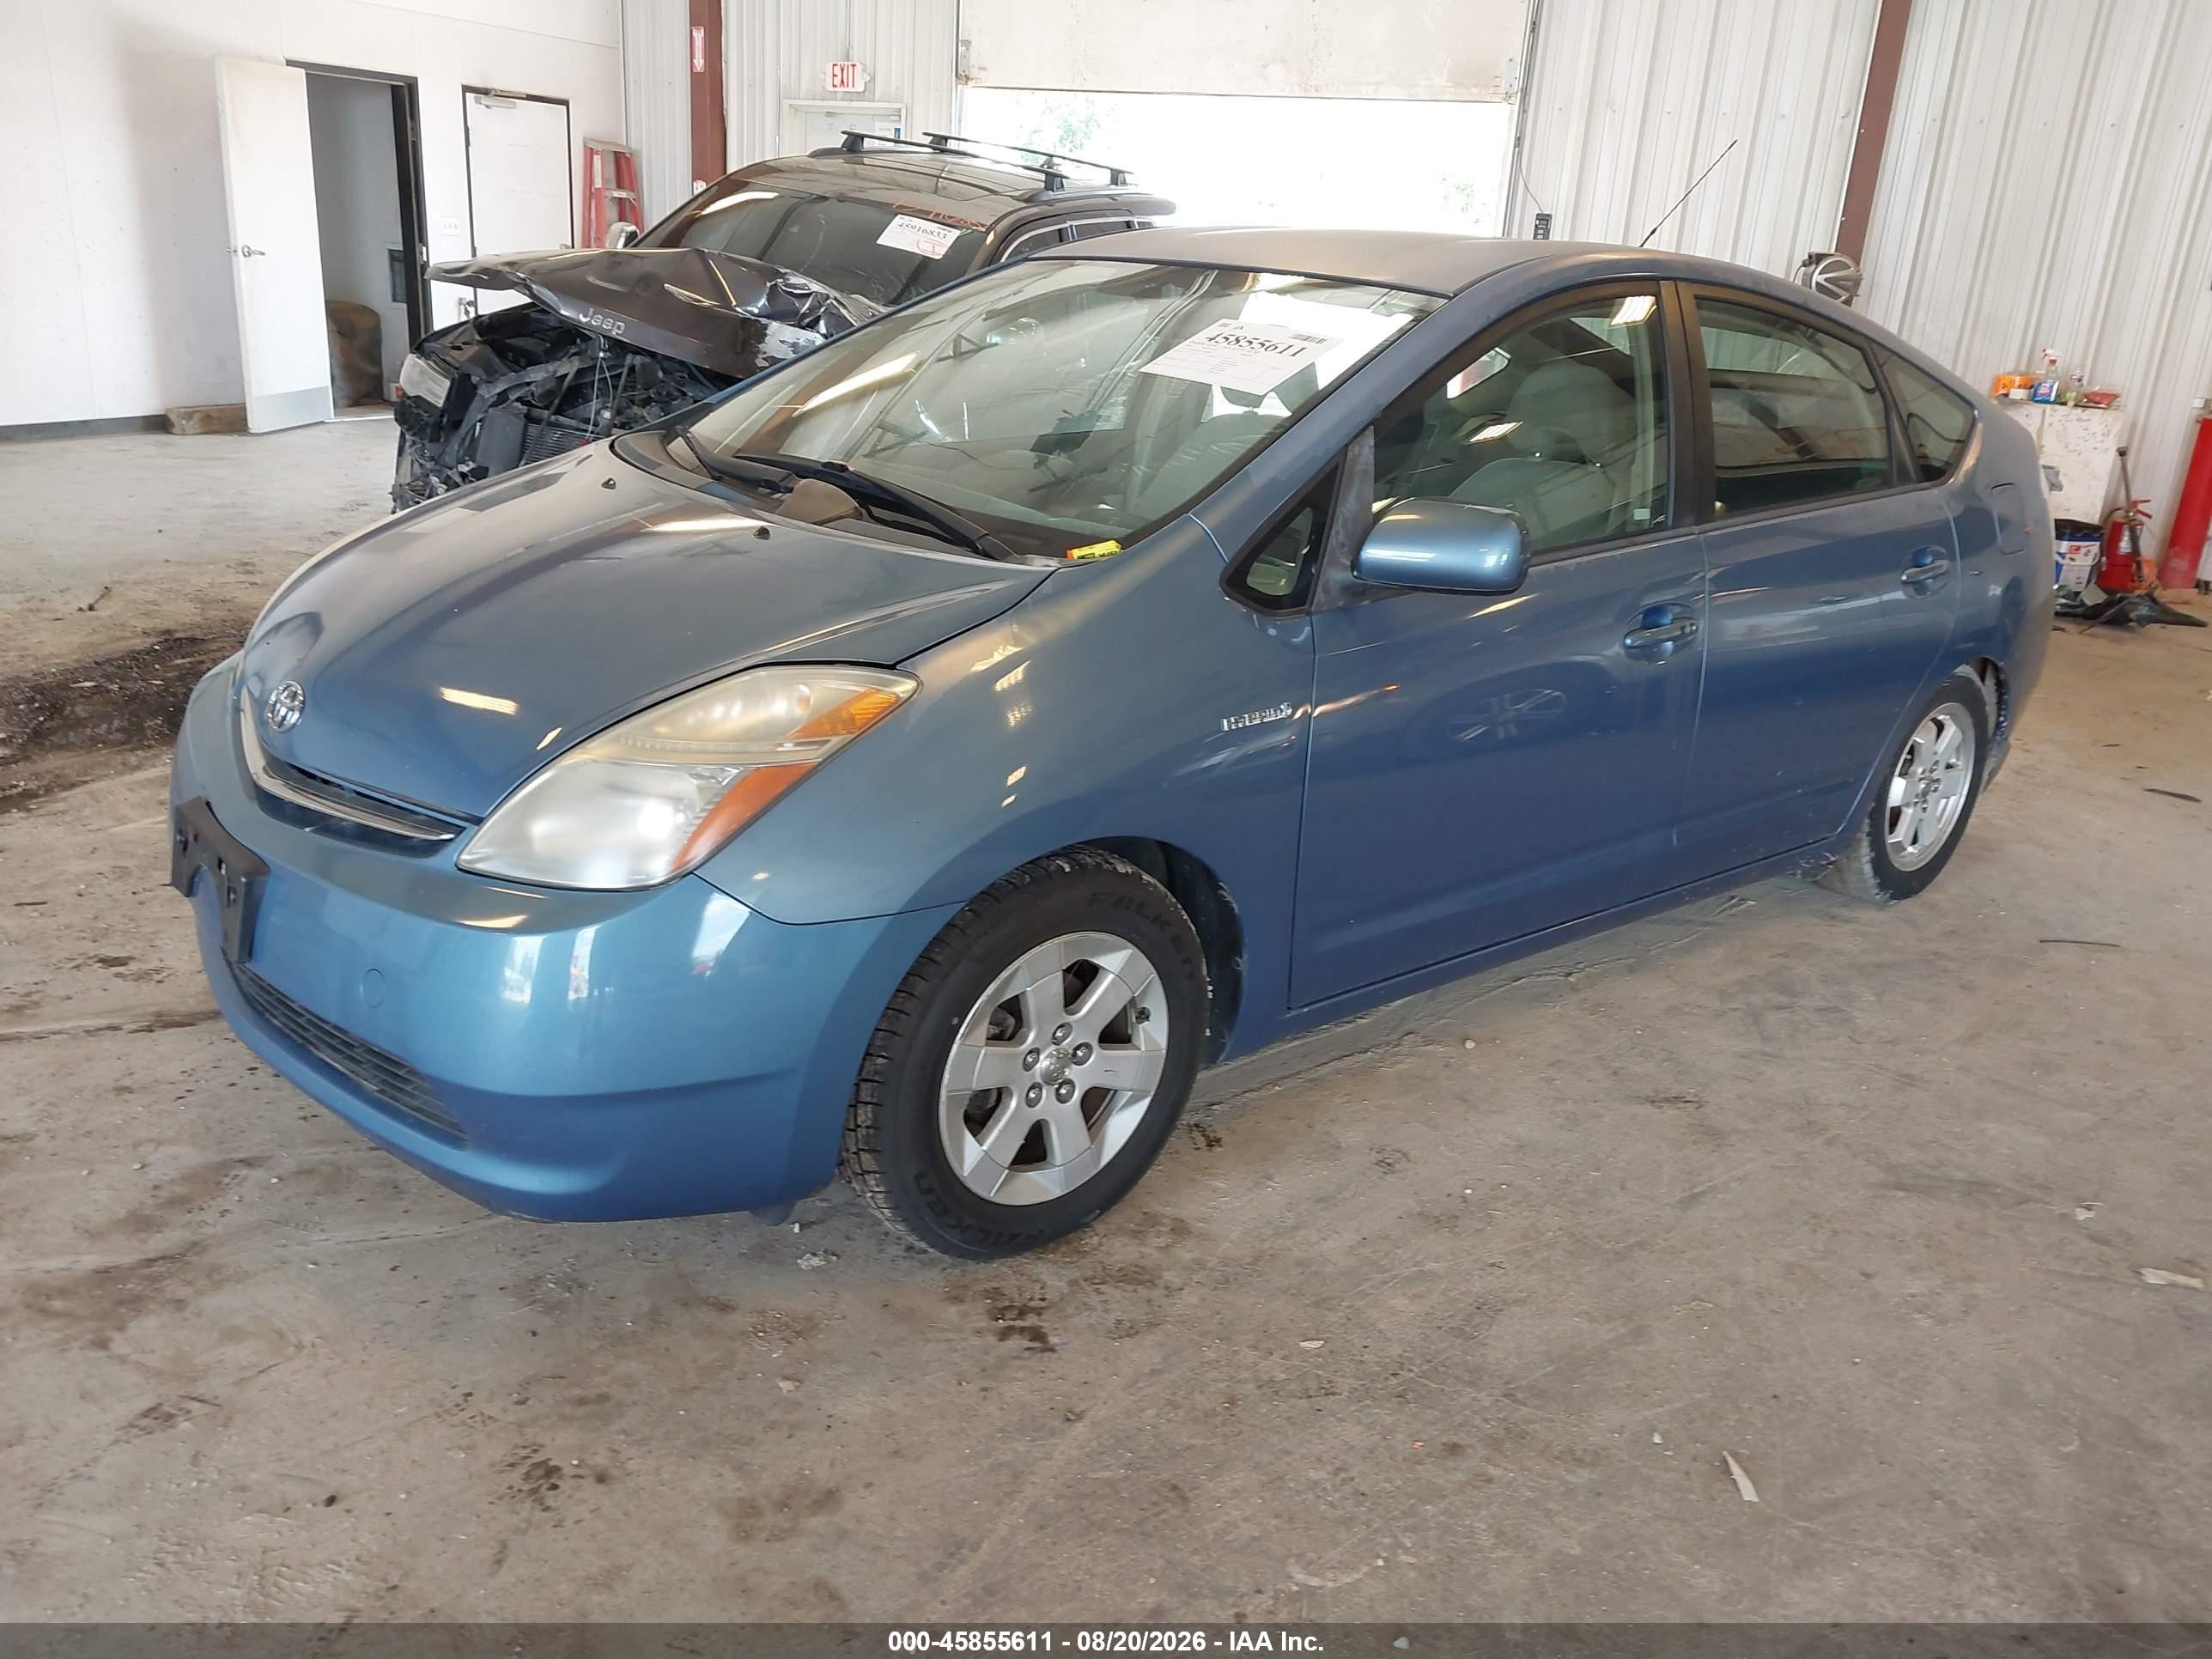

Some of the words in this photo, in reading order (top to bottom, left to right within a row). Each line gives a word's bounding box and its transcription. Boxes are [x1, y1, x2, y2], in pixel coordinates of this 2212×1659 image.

[832, 63, 857, 88] EXIT
[897, 222, 948, 240] 45916833
[579, 307, 626, 335] Jeep
[1205, 332, 1309, 357] 45855611
